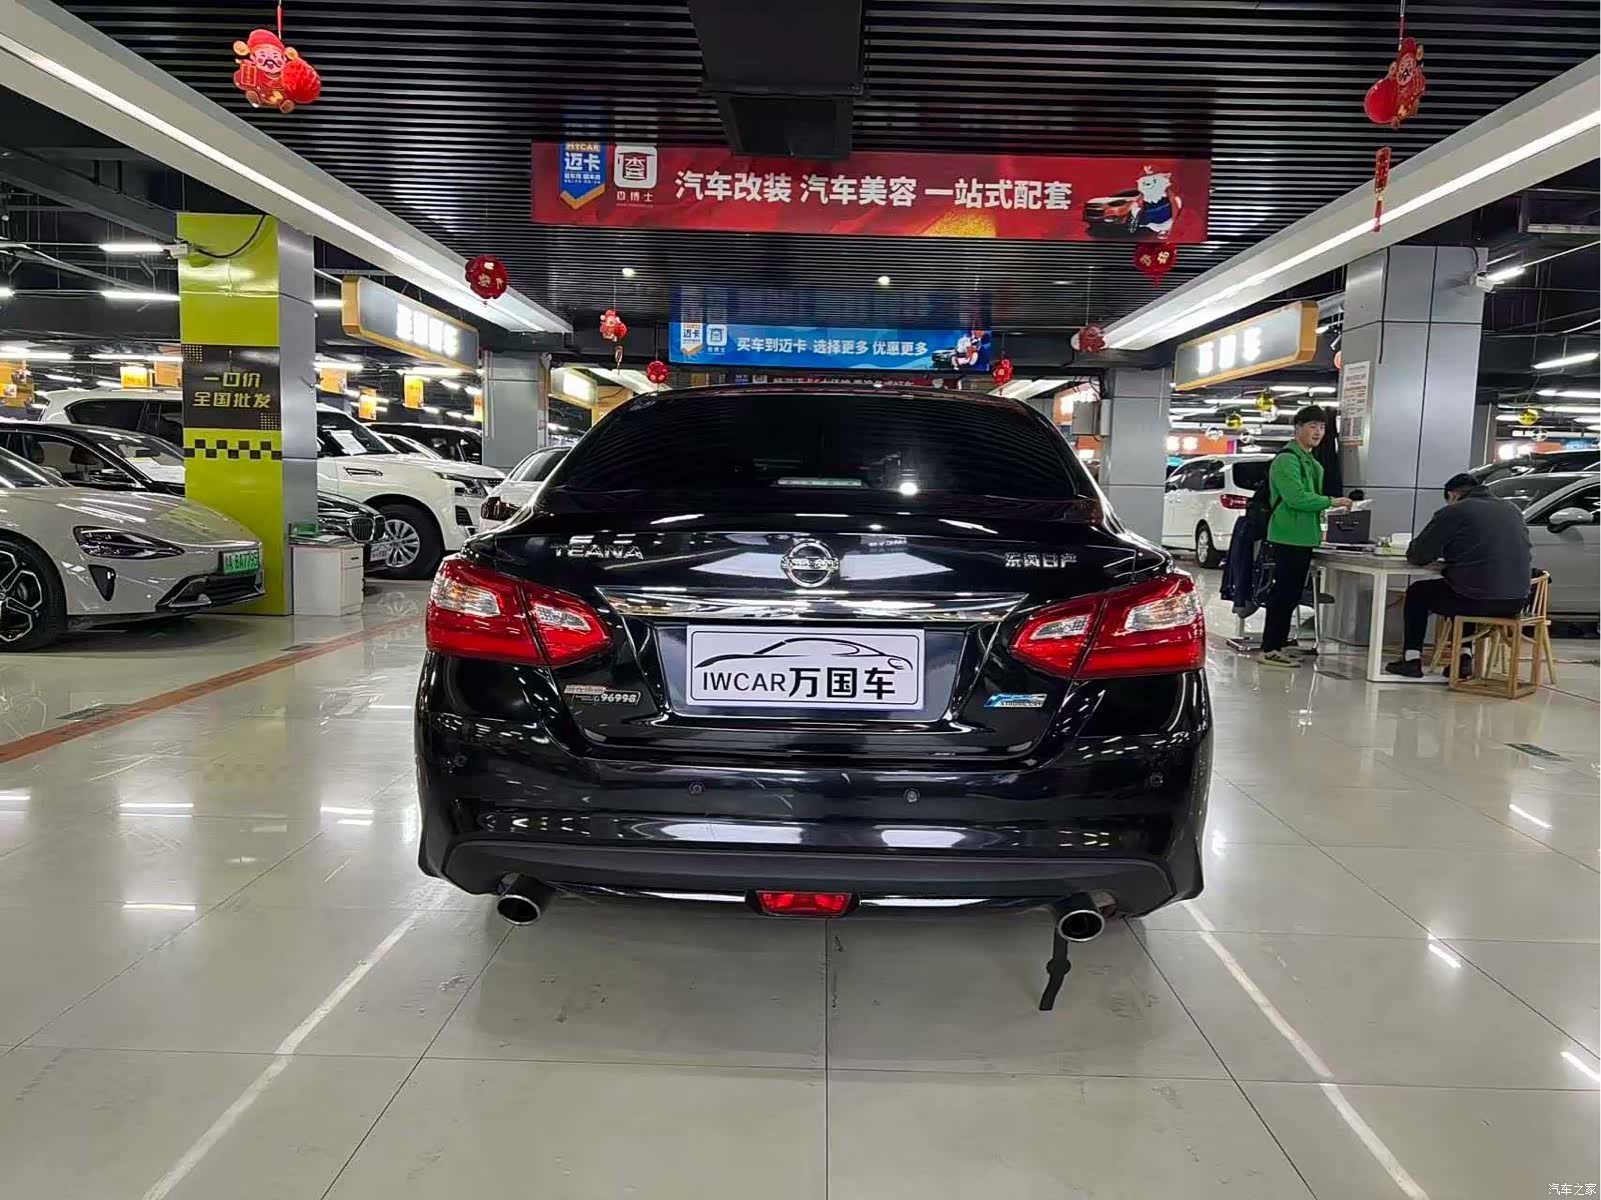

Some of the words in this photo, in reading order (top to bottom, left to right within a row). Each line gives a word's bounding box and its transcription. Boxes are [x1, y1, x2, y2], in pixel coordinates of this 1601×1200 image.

[564, 153, 601, 171] 迈卡
[675, 170, 792, 203] 汽车改装
[801, 174, 917, 207] 汽车美容
[925, 177, 1073, 210] 一站式配套
[682, 329, 701, 339] 迈卡
[737, 337, 807, 354] 买车到迈卡
[813, 339, 869, 355] 选择更多
[872, 340, 928, 357] 优惠更多
[203, 372, 260, 388] 一口价
[193, 392, 271, 409] 全国批发
[550, 545, 644, 560] TEANA
[1004, 552, 1077, 568] 东风日产
[600, 693, 637, 703] 96998
